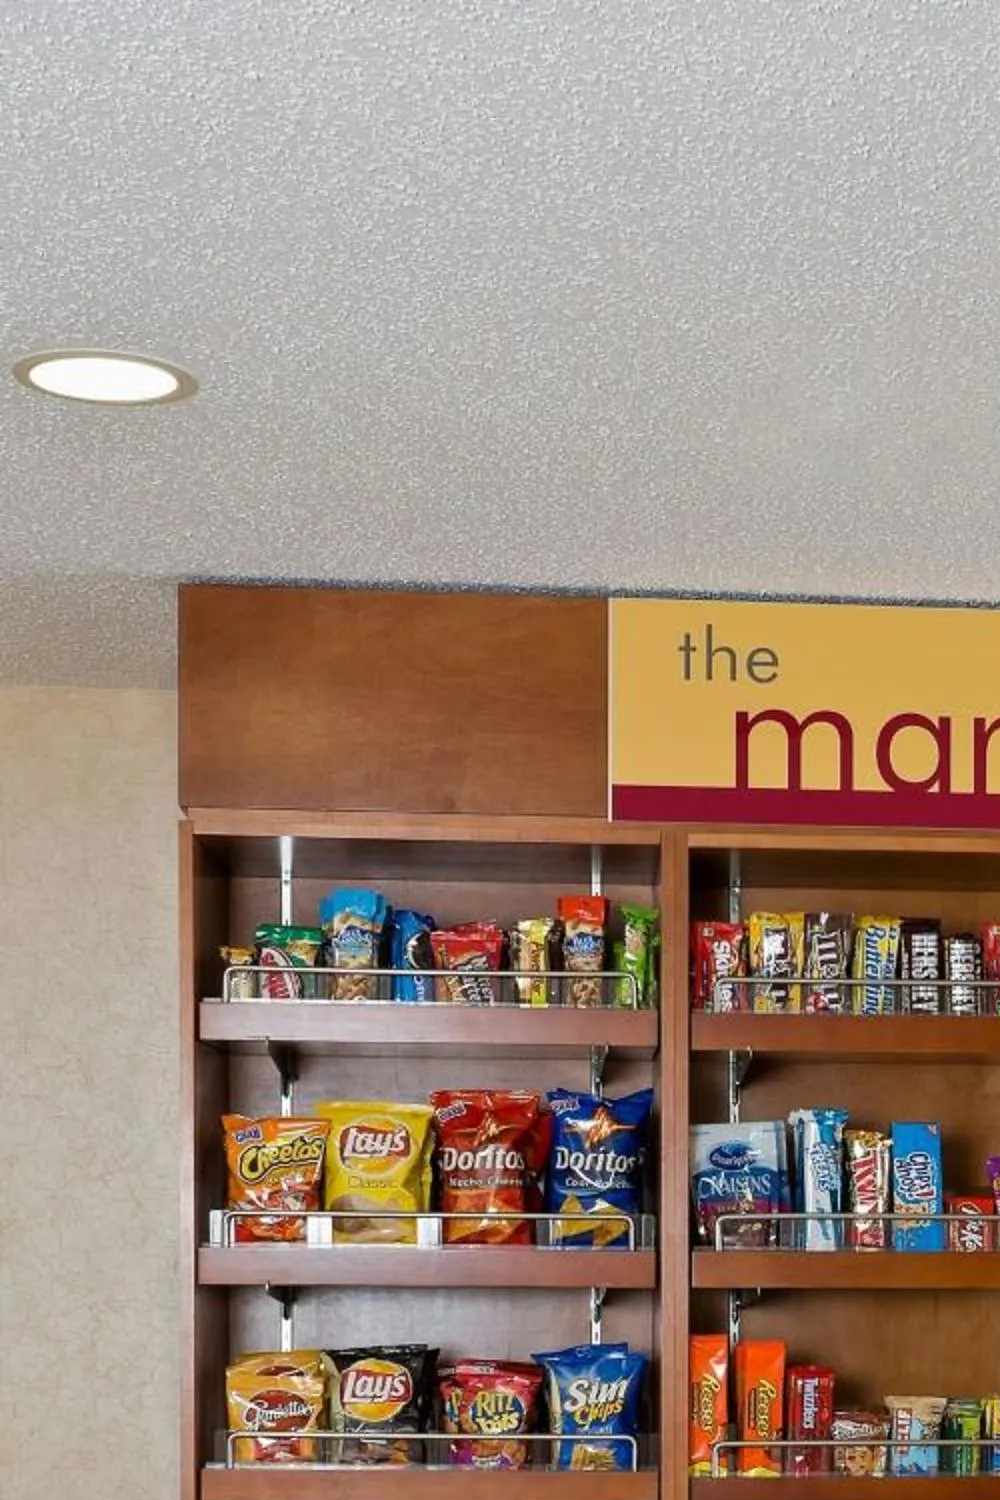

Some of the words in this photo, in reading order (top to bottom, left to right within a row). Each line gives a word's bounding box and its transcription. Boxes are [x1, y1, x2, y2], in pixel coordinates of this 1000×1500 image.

[678, 624, 779, 683] the
[713, 940, 734, 1012] Skitles
[240, 1138, 323, 1176] Cheetos
[442, 1147, 525, 1171] Doritos
[555, 1148, 637, 1172] Doritos
[564, 1378, 629, 1412] Sun
